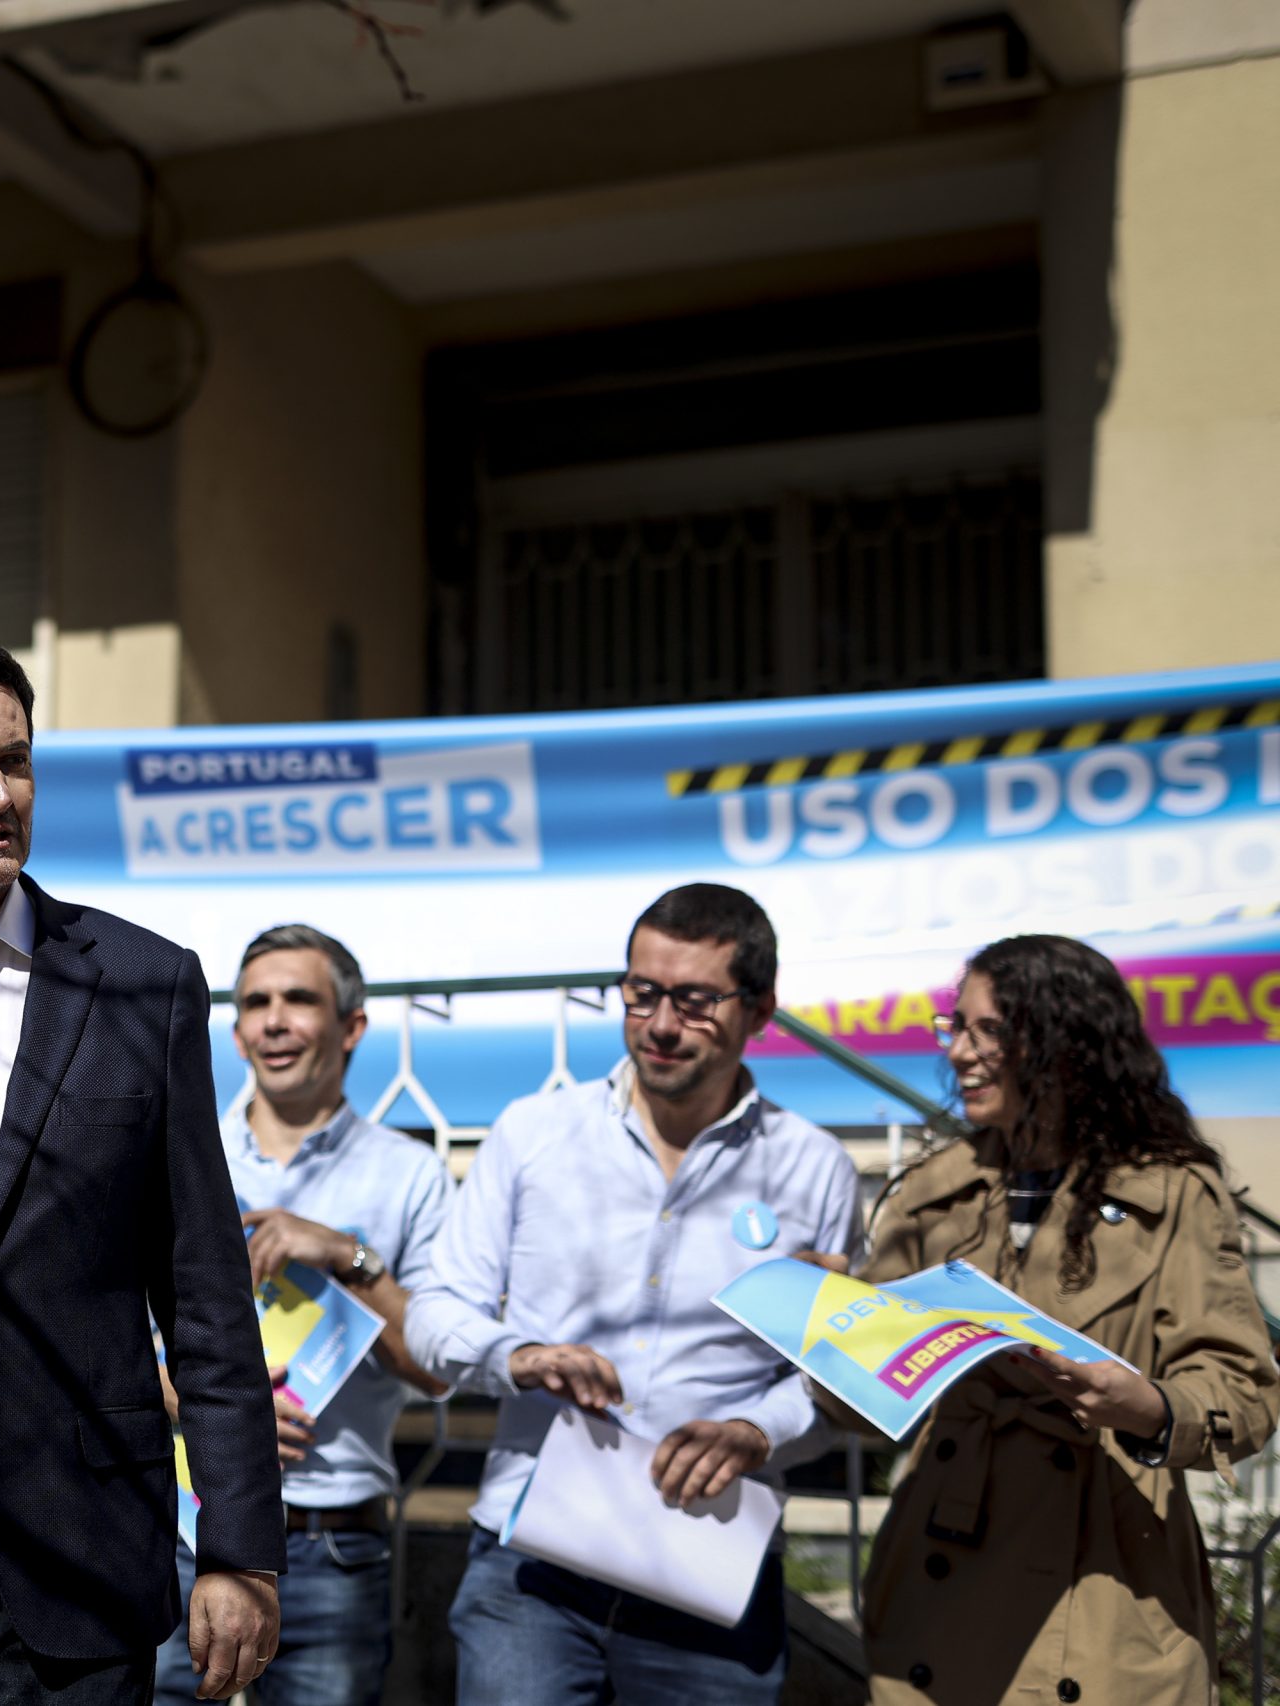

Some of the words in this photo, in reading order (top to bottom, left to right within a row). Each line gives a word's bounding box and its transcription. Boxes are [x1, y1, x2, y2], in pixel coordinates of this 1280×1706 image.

[140, 752, 363, 784] PORTUGAL
[139, 814, 168, 857] A
[175, 777, 517, 856] CRESCER
[721, 768, 957, 866] USO
[984, 738, 1249, 838] DOS
[778, 993, 938, 1038] ARA
